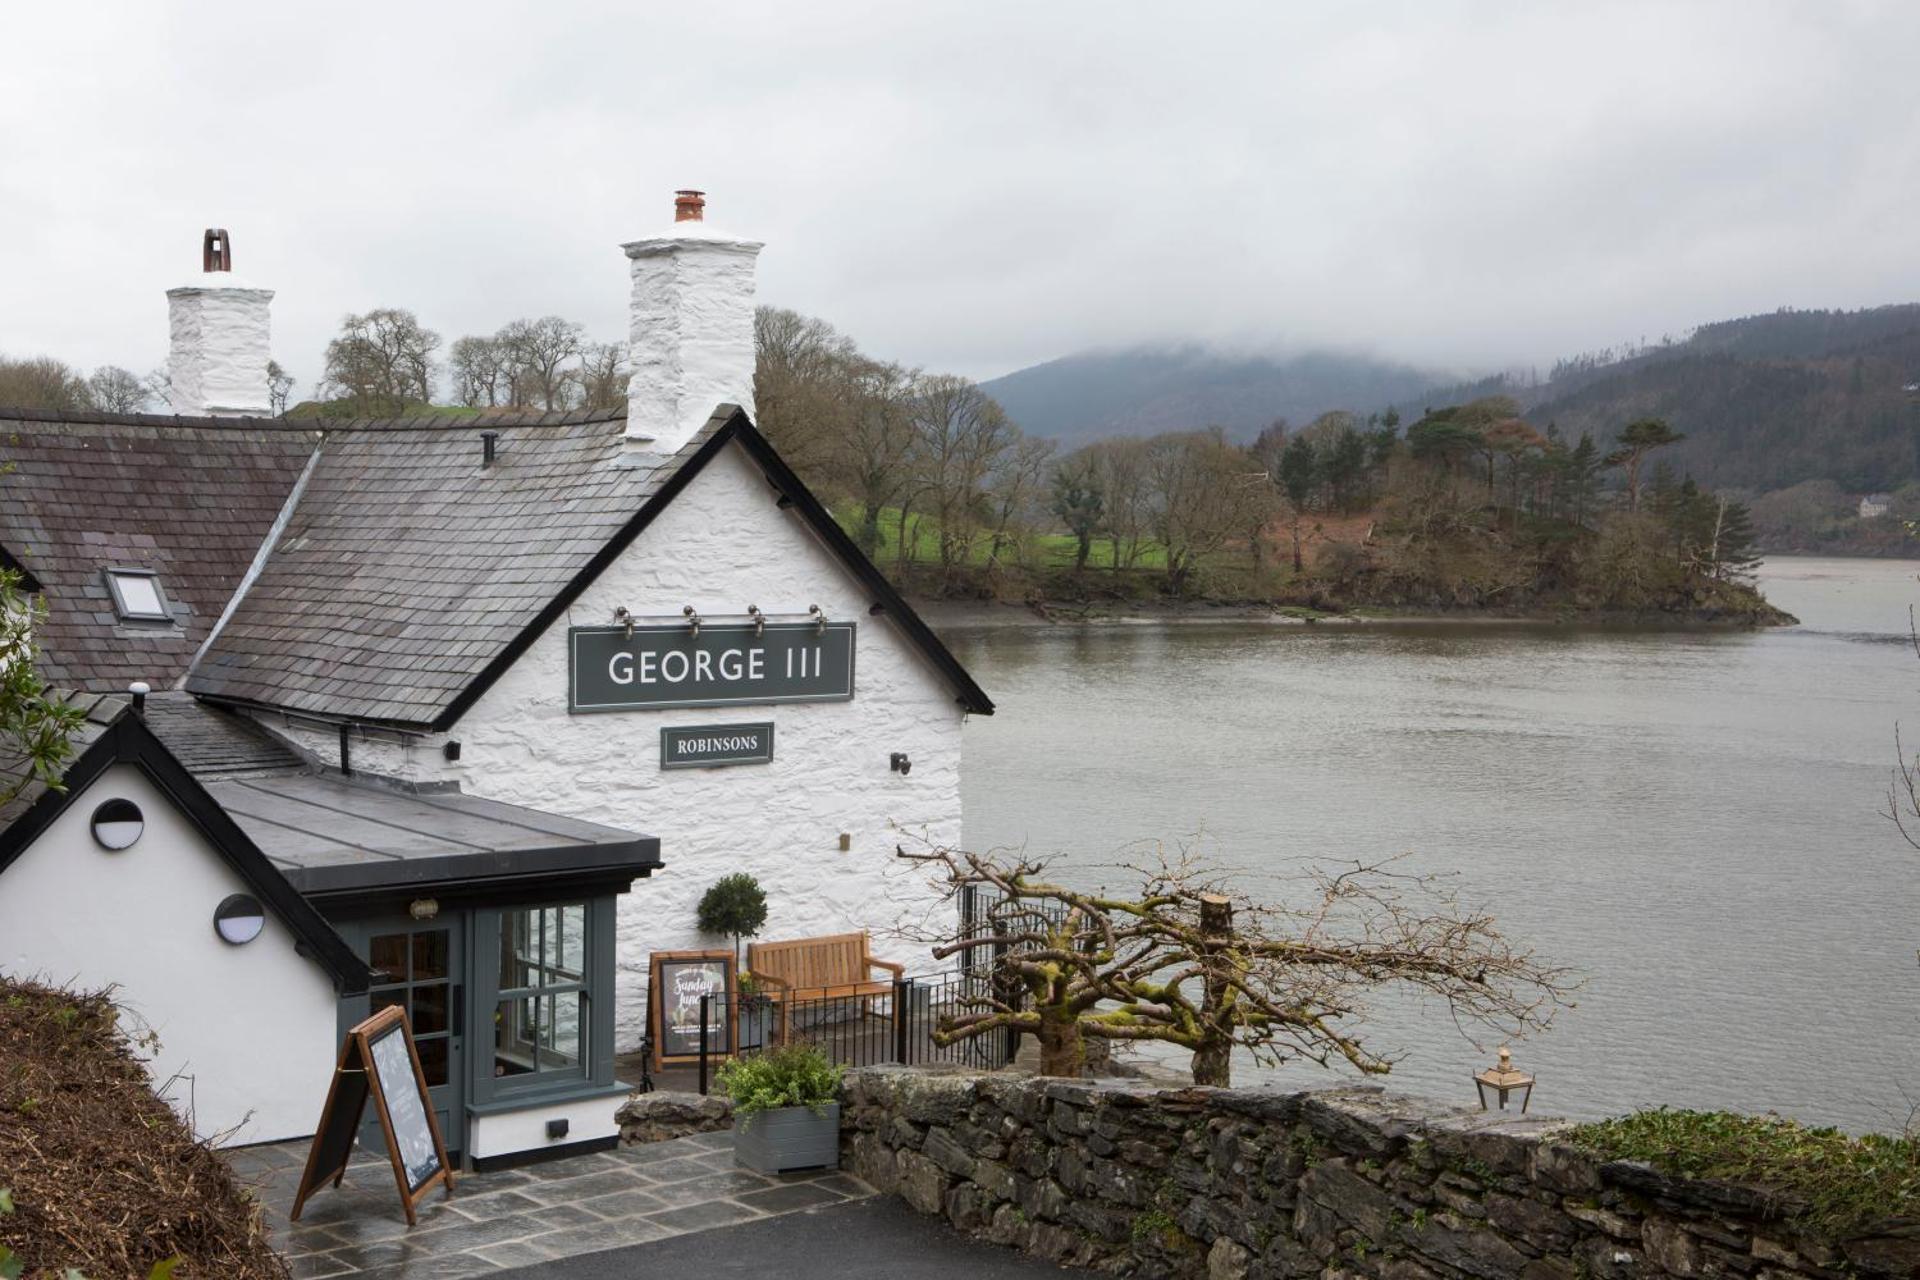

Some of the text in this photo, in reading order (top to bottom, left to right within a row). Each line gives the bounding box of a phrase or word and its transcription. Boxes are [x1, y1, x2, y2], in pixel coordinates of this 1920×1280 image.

[608, 647, 821, 684] GEORGE III
[677, 735, 758, 754] ROBINSONS
